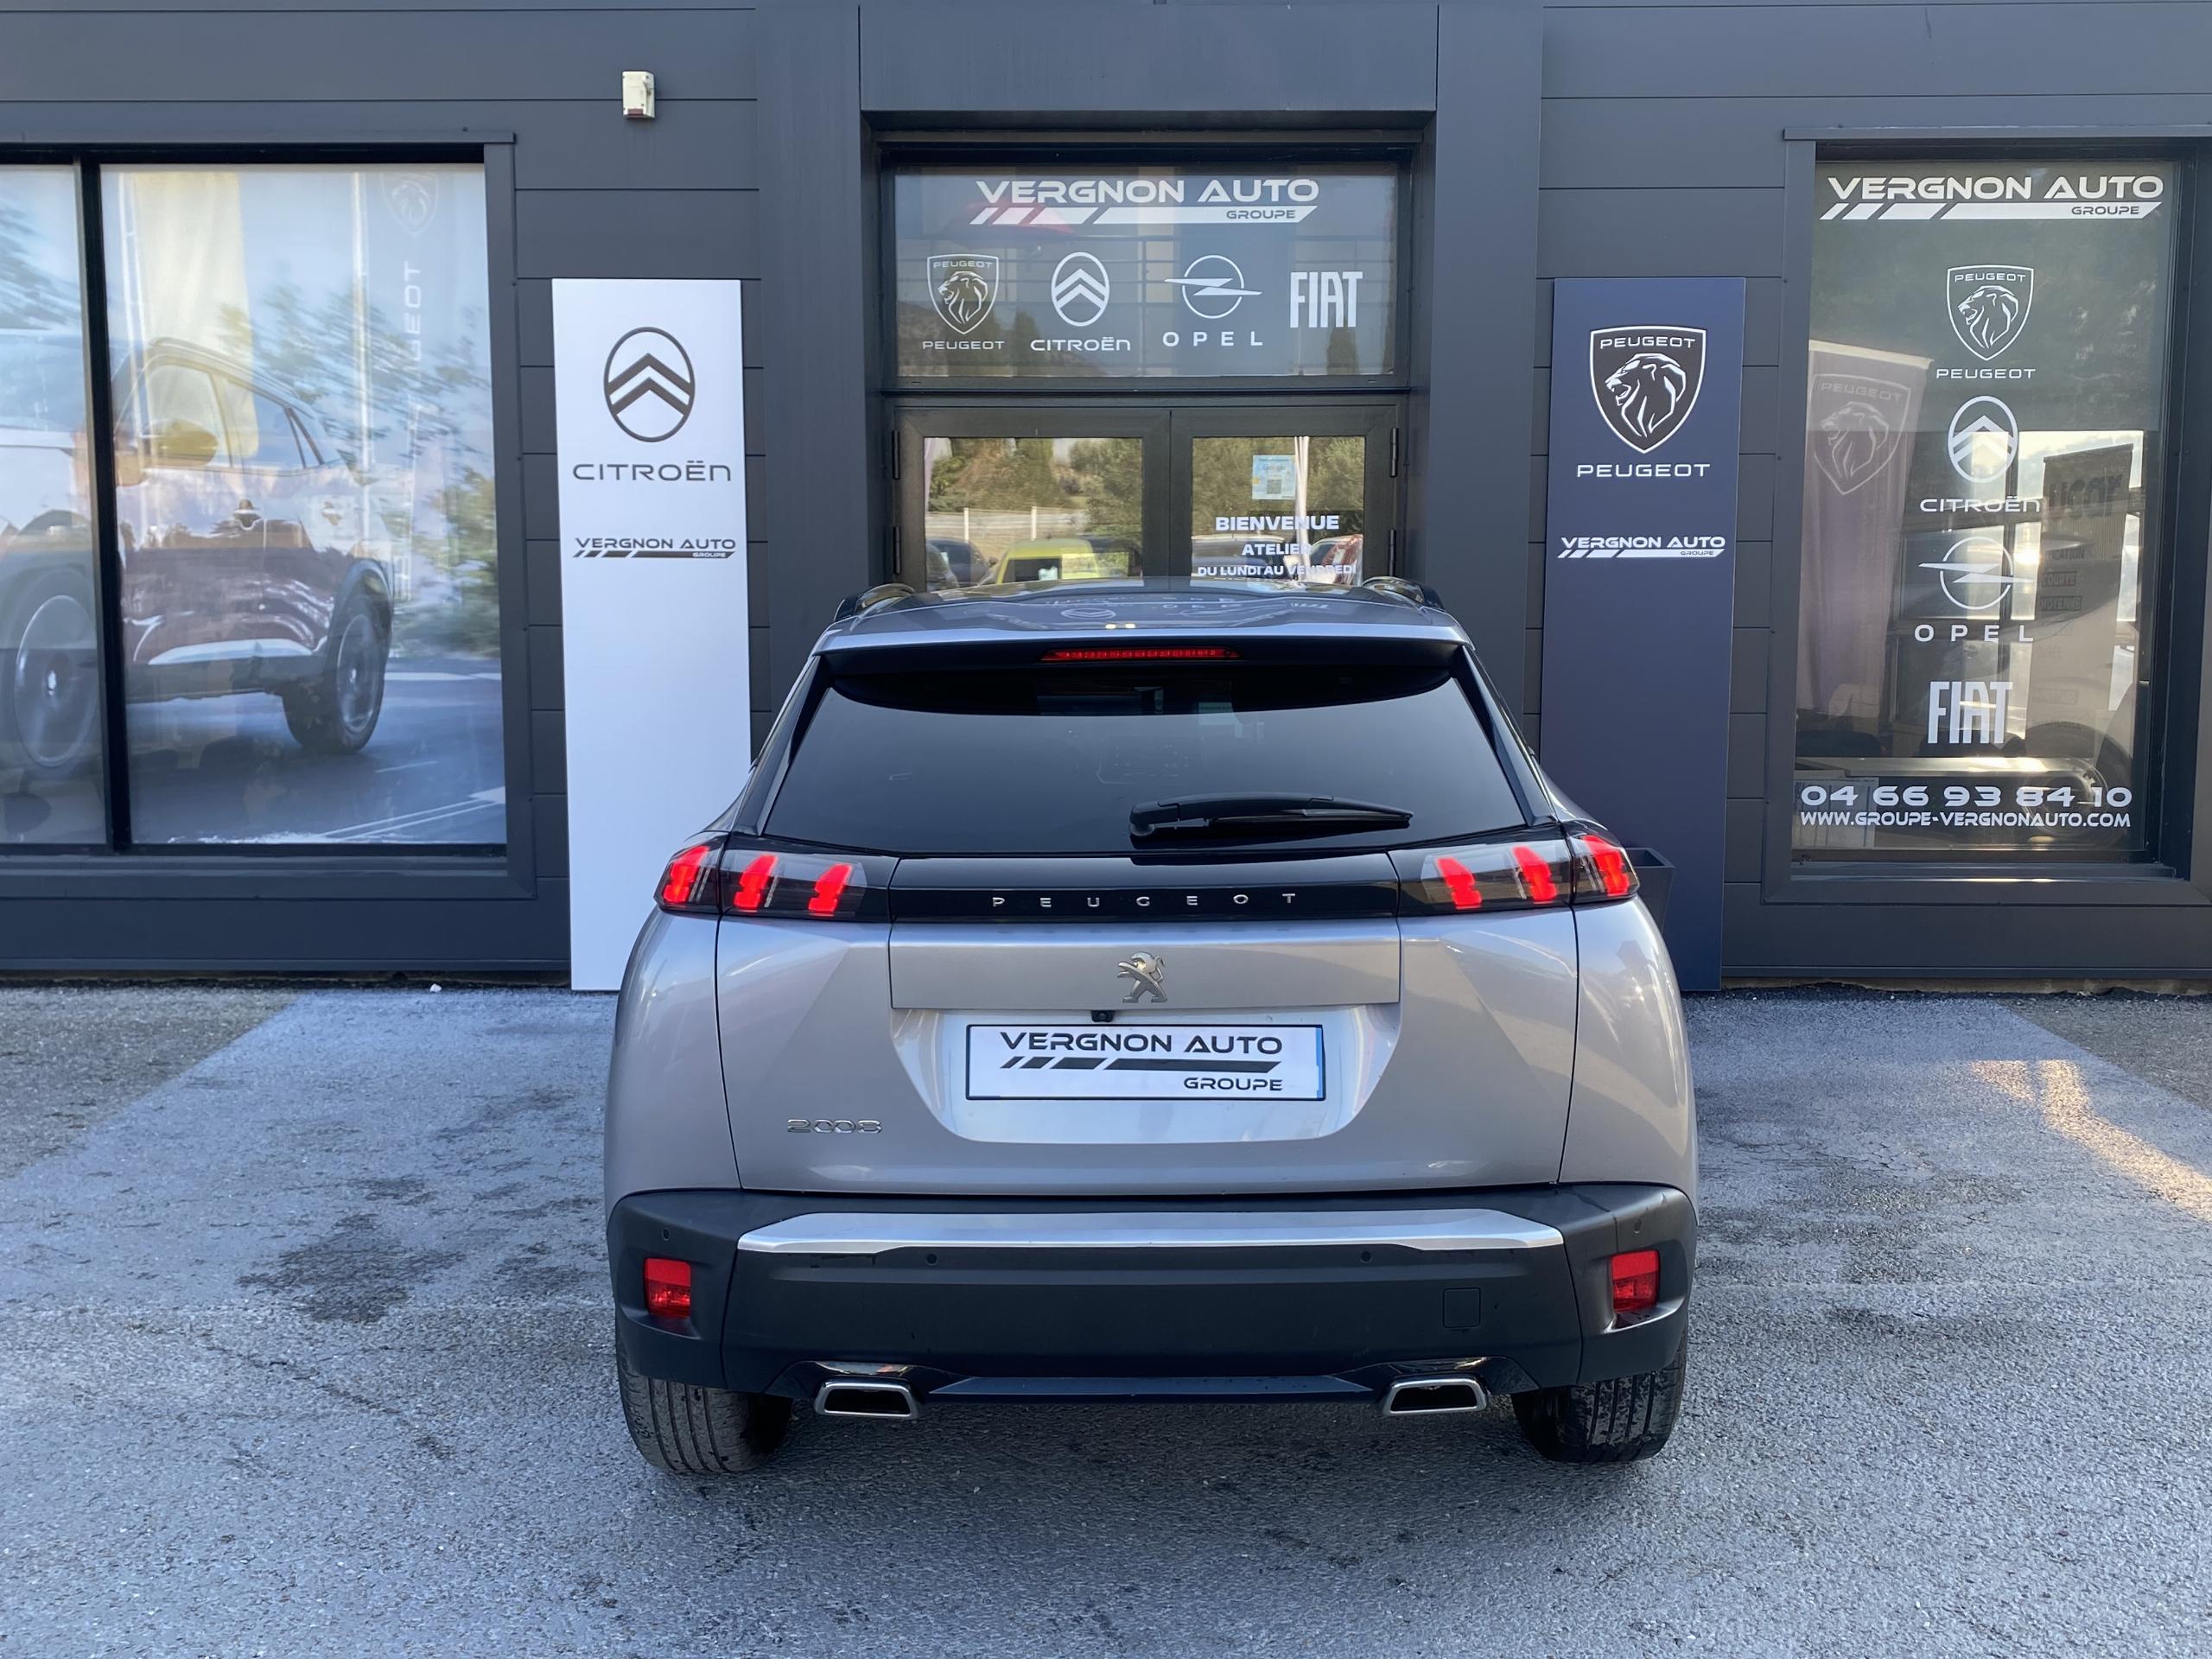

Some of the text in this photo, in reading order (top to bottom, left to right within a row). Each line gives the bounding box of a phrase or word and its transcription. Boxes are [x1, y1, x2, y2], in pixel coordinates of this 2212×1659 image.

[976, 178, 1319, 204] VERGNON AUTO
[1827, 175, 2164, 200] VERGNON AUTO
[1225, 209, 1297, 219] GROUPE
[2070, 206, 2141, 215] GROUPE
[932, 260, 993, 270] PEUGEOT
[1954, 272, 2026, 283] PEUGEOT
[1290, 271, 1363, 328] FIAT
[922, 340, 1005, 351] PEUGEOT
[1162, 331, 1262, 348] OPEL
[1600, 336, 1696, 349] PEUGEOT
[1936, 368, 2036, 379] PEUGEOT
[1821, 382, 1903, 402] PEUGEOT
[1577, 463, 1711, 478] PEUGEOT
[1215, 515, 1339, 531] BIENVENUE
[575, 537, 736, 550] VERGNON AUTO
[1560, 536, 1726, 548] VERGNON AUTO
[1198, 566, 1218, 576] DU
[1220, 565, 1262, 576] LUNDI
[1264, 565, 1284, 575] AU
[1914, 624, 2035, 642] OPEL
[1927, 681, 2013, 744] FIAT
[1801, 786, 2133, 808] 04 66 93 84 10
[1801, 811, 2131, 828] WWW.GROUPE-VERGNONAUTO.COM
[991, 893, 1296, 908] PEUGEOT
[1000, 1032, 1283, 1055] VERGNON AUTO
[1183, 1077, 1283, 1091] GROUPE
[787, 1119, 883, 1134] 2008
